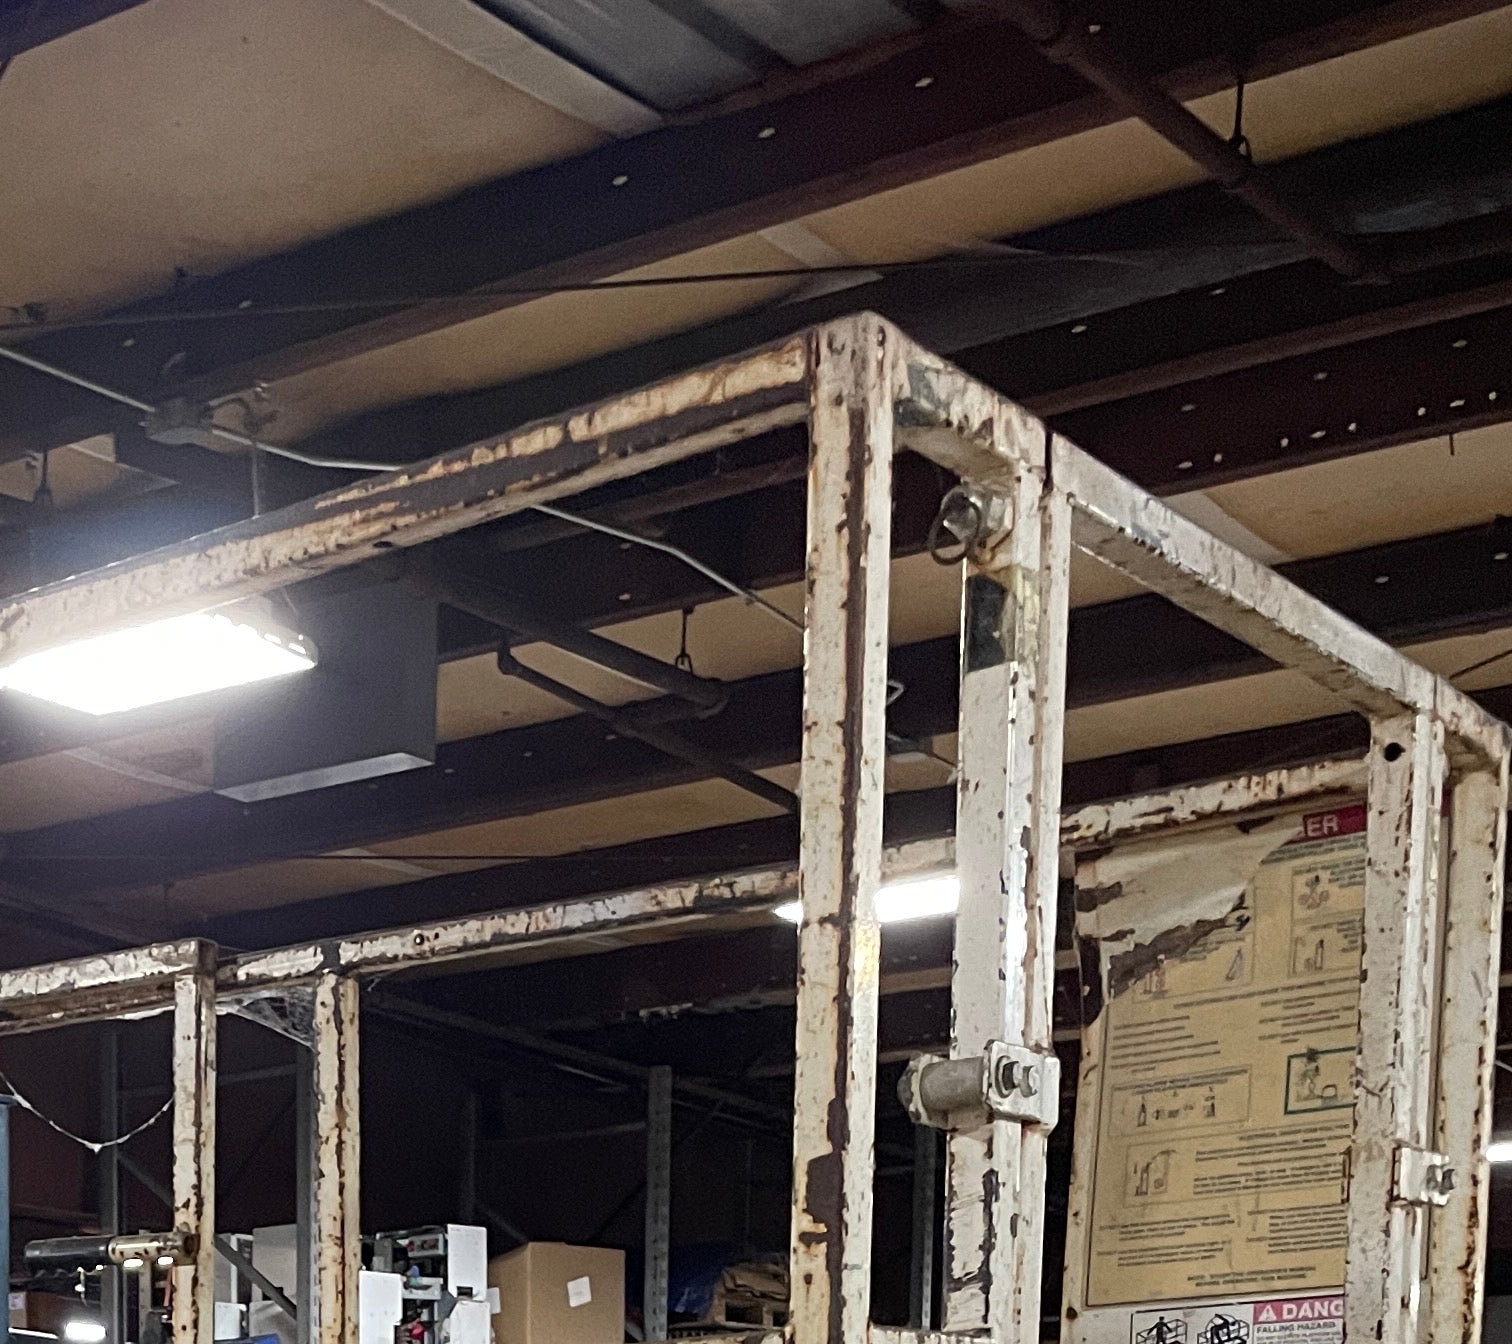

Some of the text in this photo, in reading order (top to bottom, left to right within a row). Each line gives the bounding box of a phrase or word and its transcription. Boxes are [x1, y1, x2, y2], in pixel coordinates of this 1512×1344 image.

[1282, 1300, 1344, 1320] DANG
[1256, 1321, 1337, 1334] FALLING HAZARD
